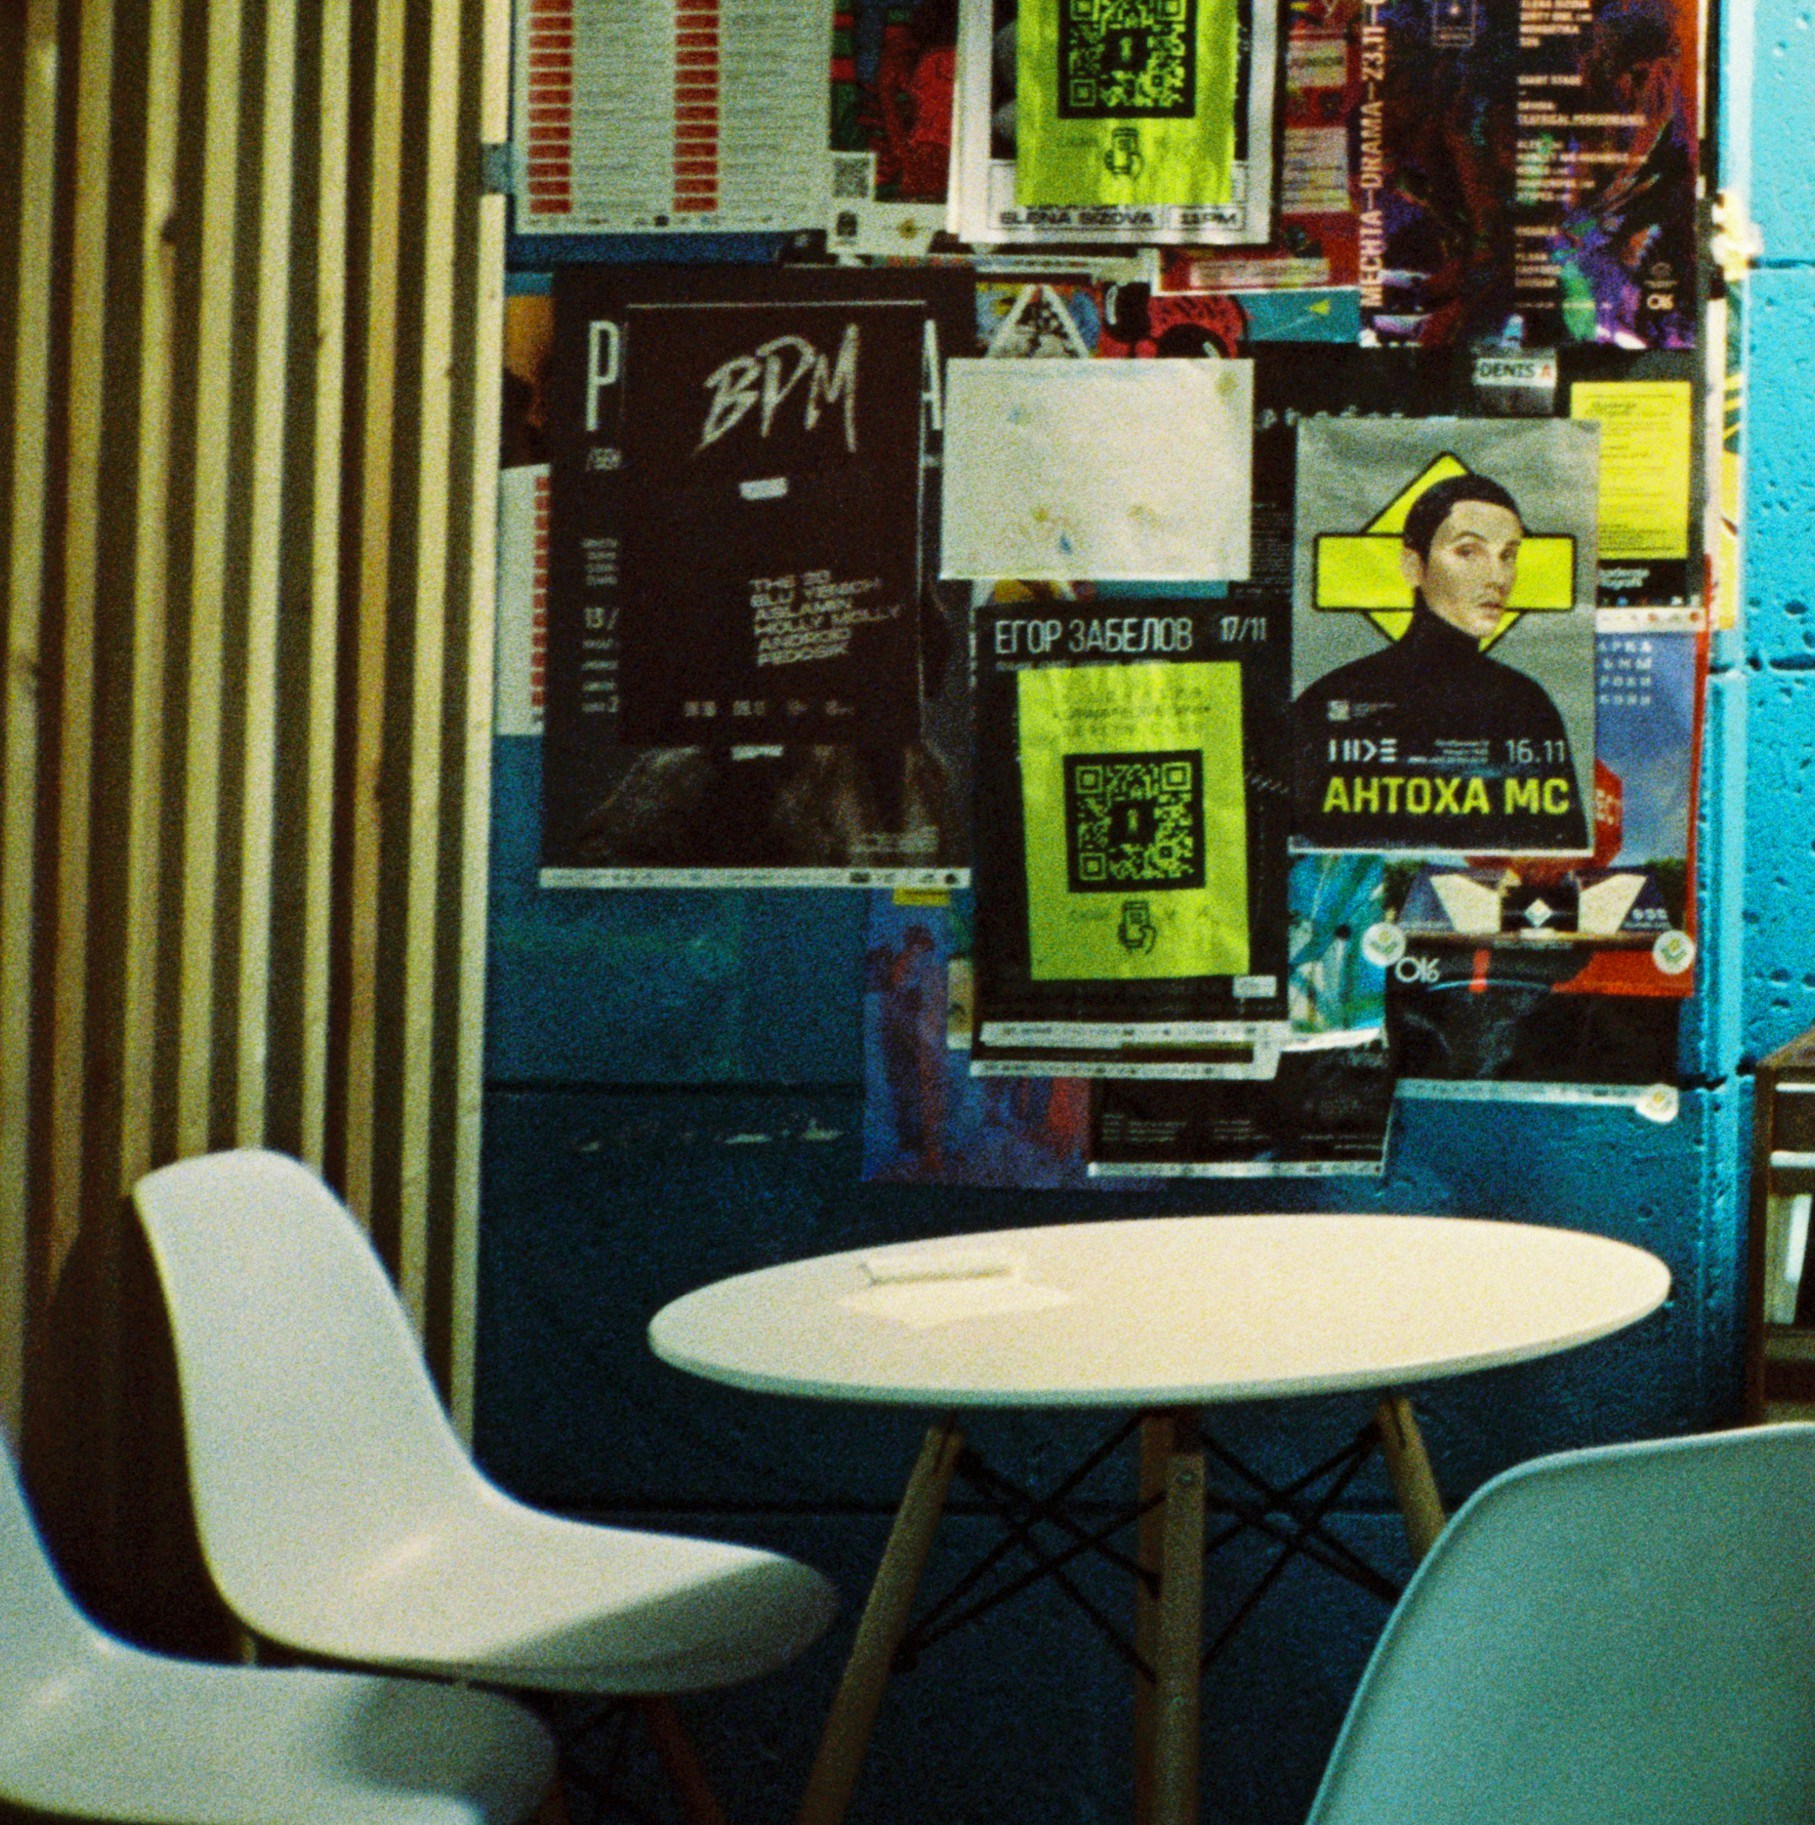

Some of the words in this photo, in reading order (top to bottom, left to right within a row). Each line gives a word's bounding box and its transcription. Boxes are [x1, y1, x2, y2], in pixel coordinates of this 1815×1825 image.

[995, 619, 1062, 653] ЕГОР
[1068, 618, 1194, 651] ЗАБЕЛОВ
[1505, 739, 1565, 764] 16.11
[1322, 776, 1491, 816] АНТОХА
